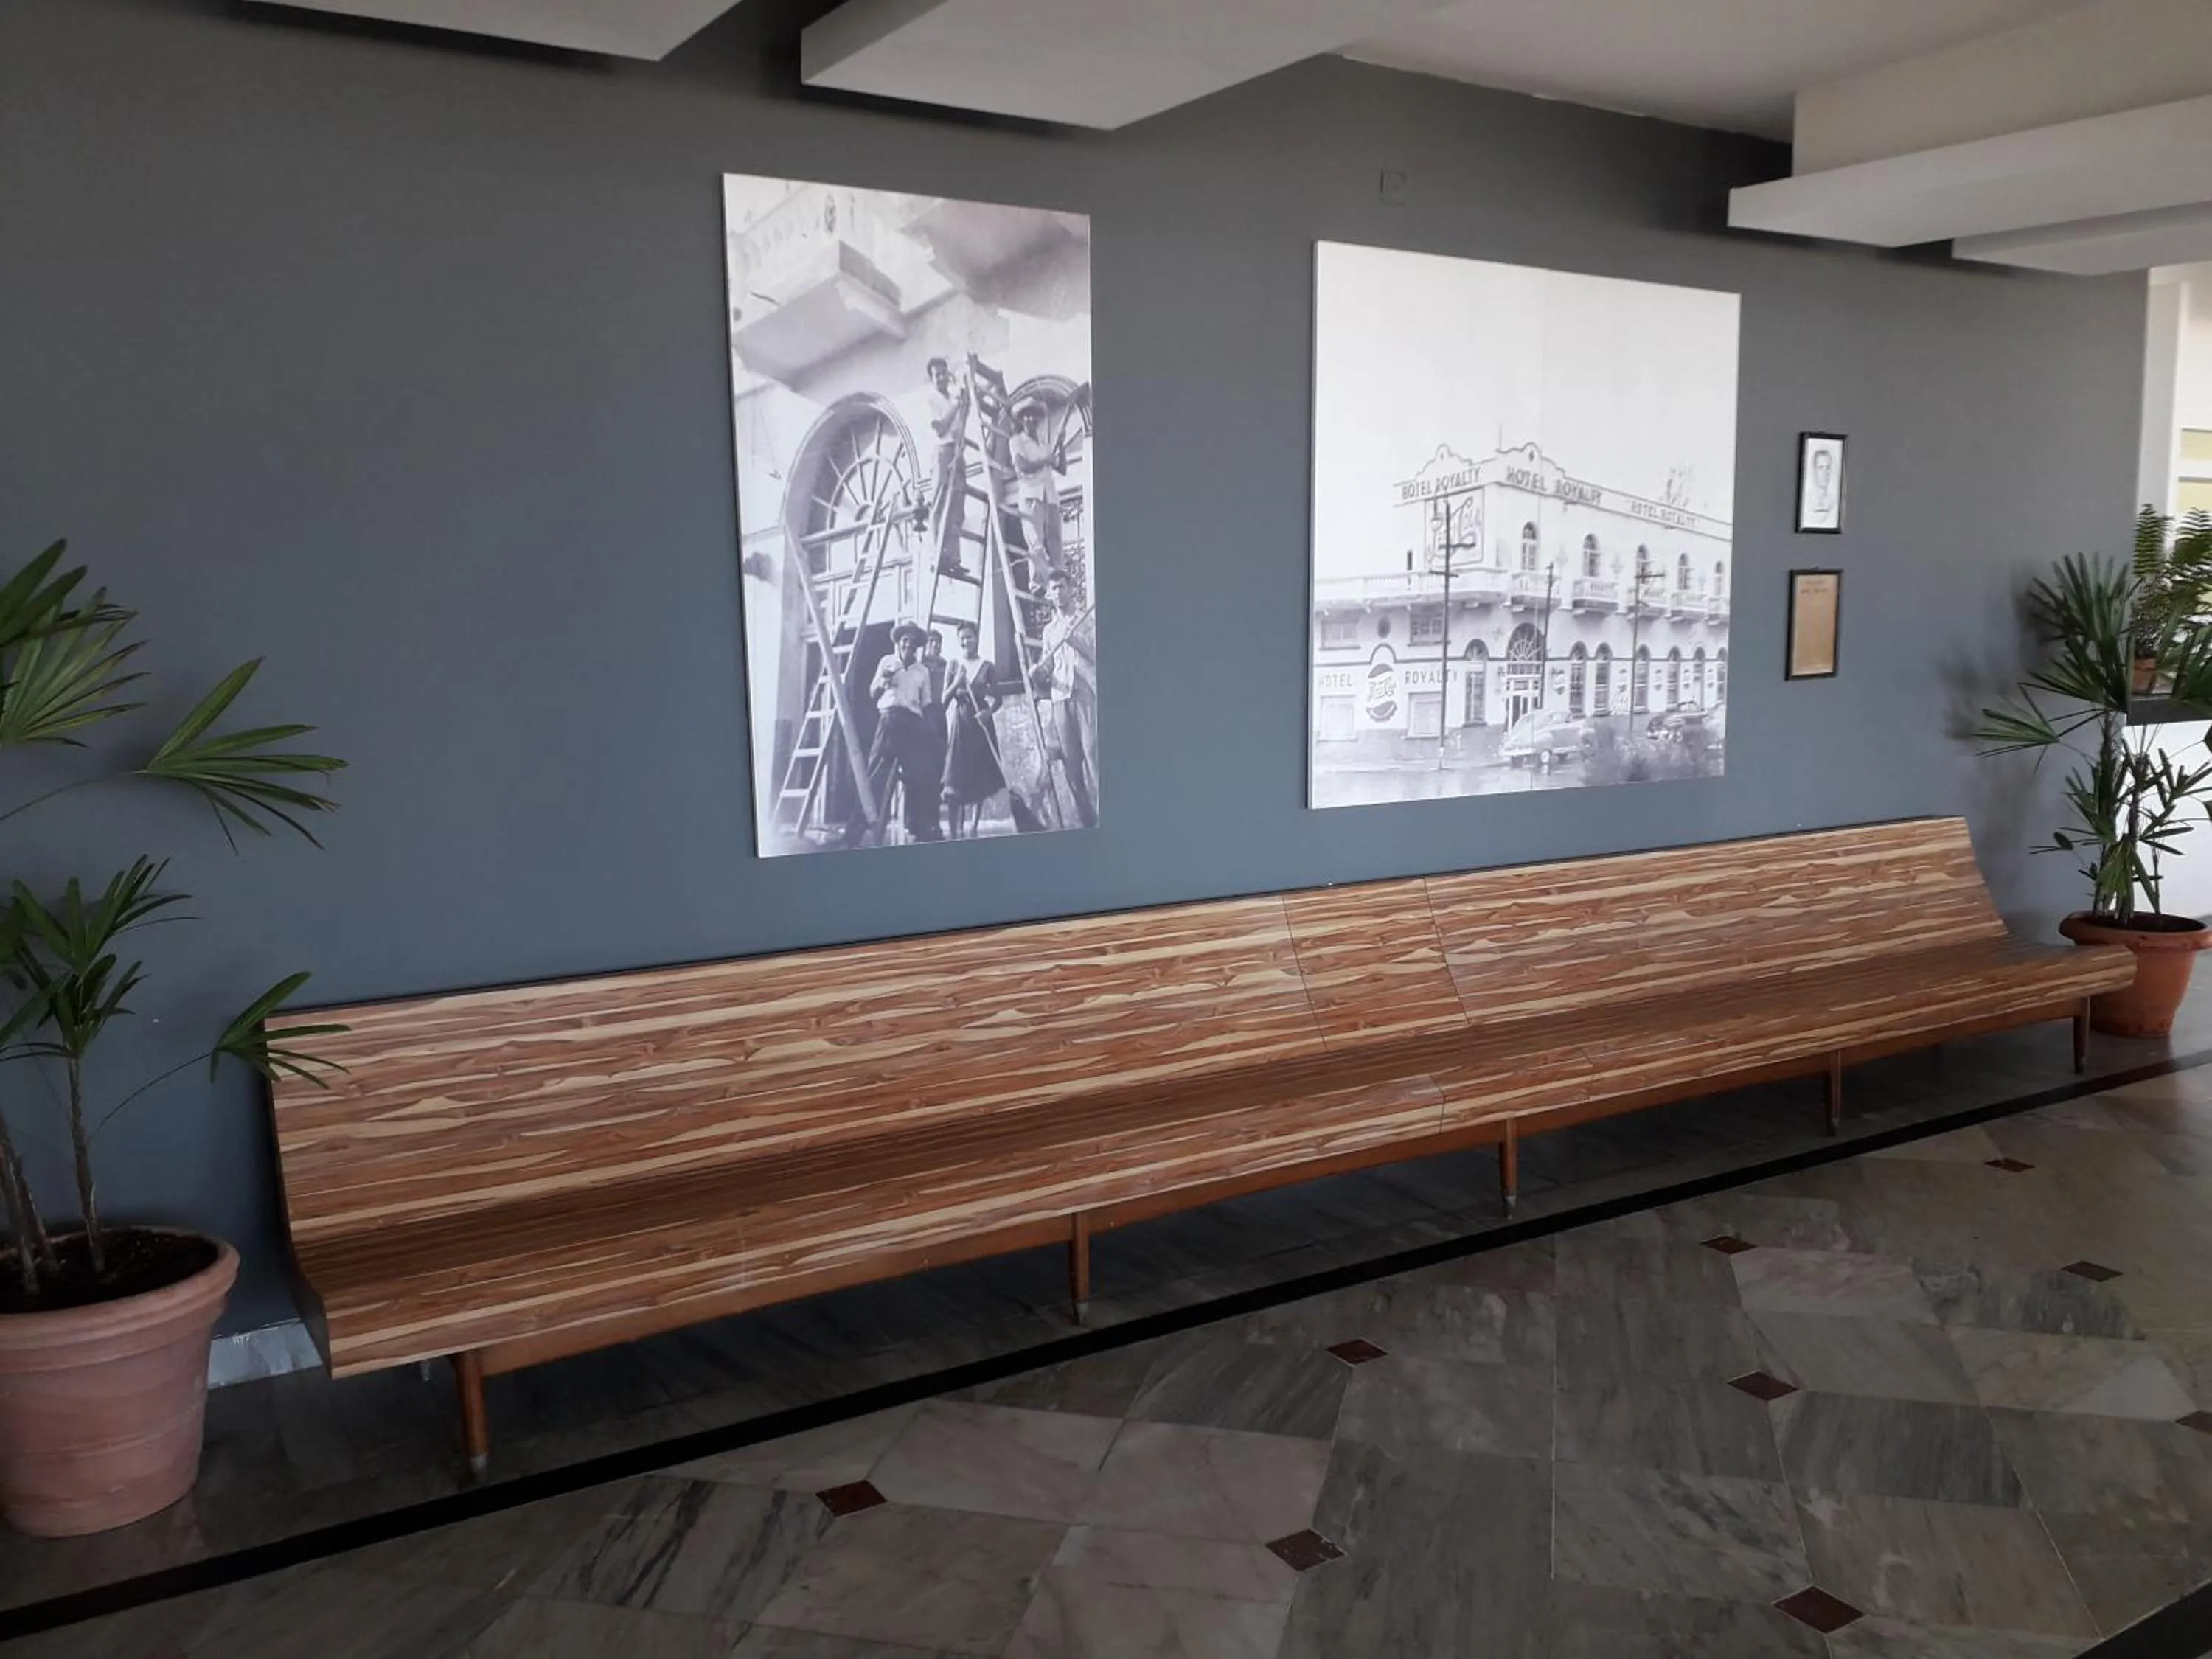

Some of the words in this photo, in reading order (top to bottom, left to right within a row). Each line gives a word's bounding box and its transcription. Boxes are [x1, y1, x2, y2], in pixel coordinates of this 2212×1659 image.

[1506, 465, 1548, 492] HOTEL
[1555, 480, 1603, 506] ROYALTY
[1319, 674, 1353, 687] HOTEL
[1405, 669, 1458, 684] ROYALTY
